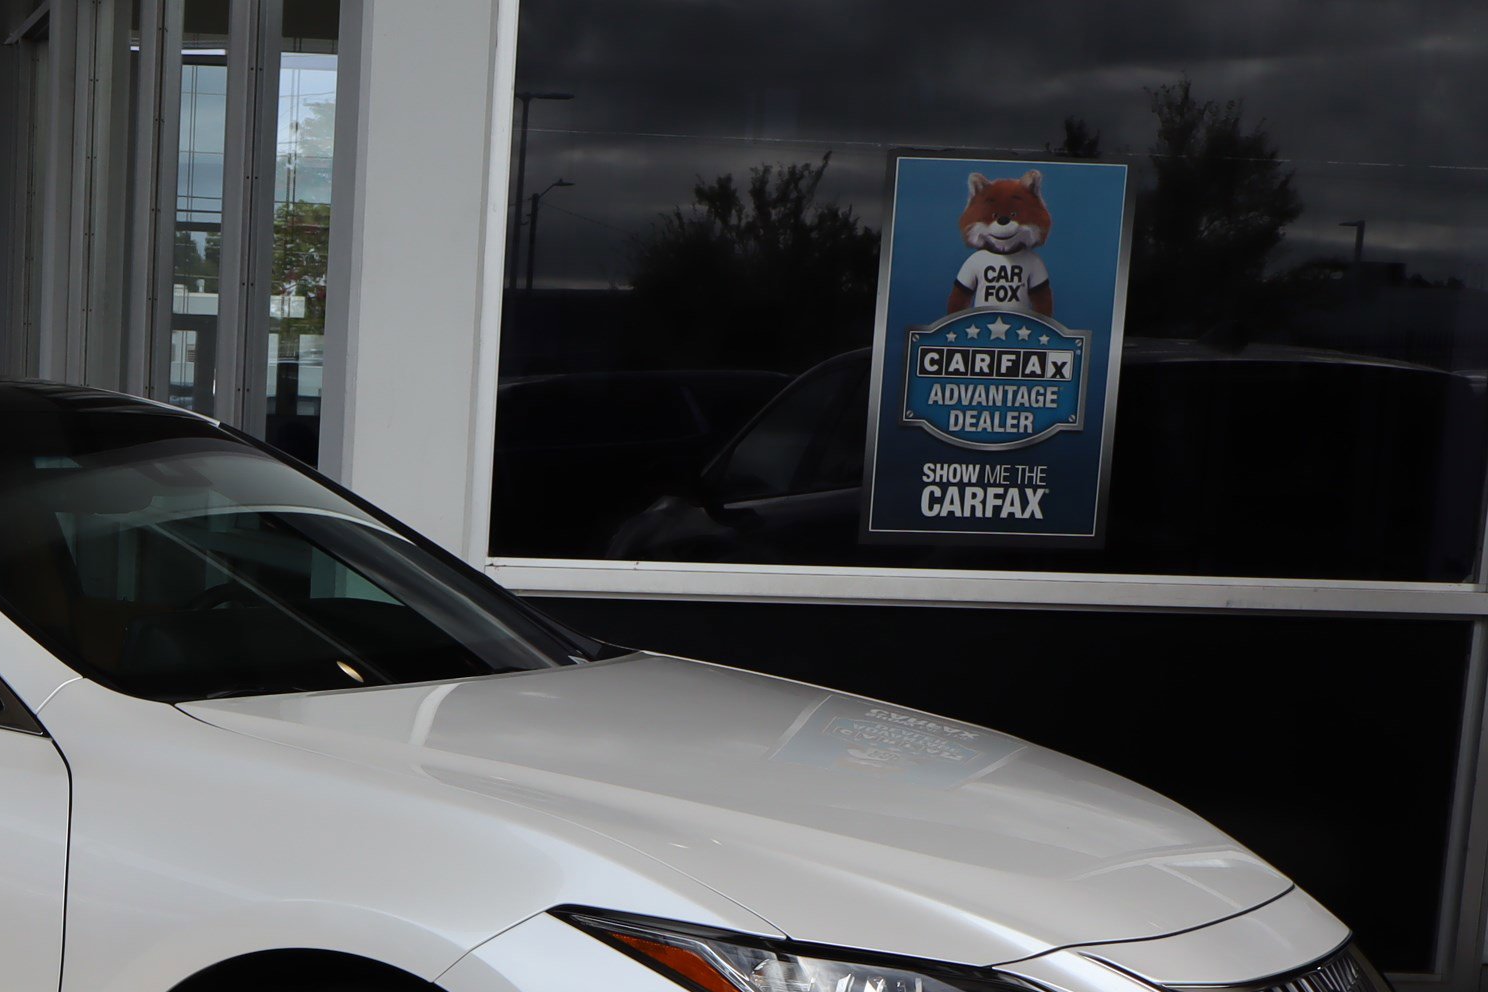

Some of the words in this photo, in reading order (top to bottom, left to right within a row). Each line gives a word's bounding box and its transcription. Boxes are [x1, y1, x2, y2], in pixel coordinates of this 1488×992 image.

[983, 264, 1023, 283] CAR
[984, 284, 1021, 302] FOX
[923, 351, 1068, 379] CARFAX
[927, 383, 1059, 408] ADVANTAGE
[948, 409, 1034, 433] DEALER
[922, 463, 980, 483] SHOW
[984, 464, 1011, 484] ME
[1015, 465, 1047, 485] THE
[920, 485, 1045, 519] CARFAX
